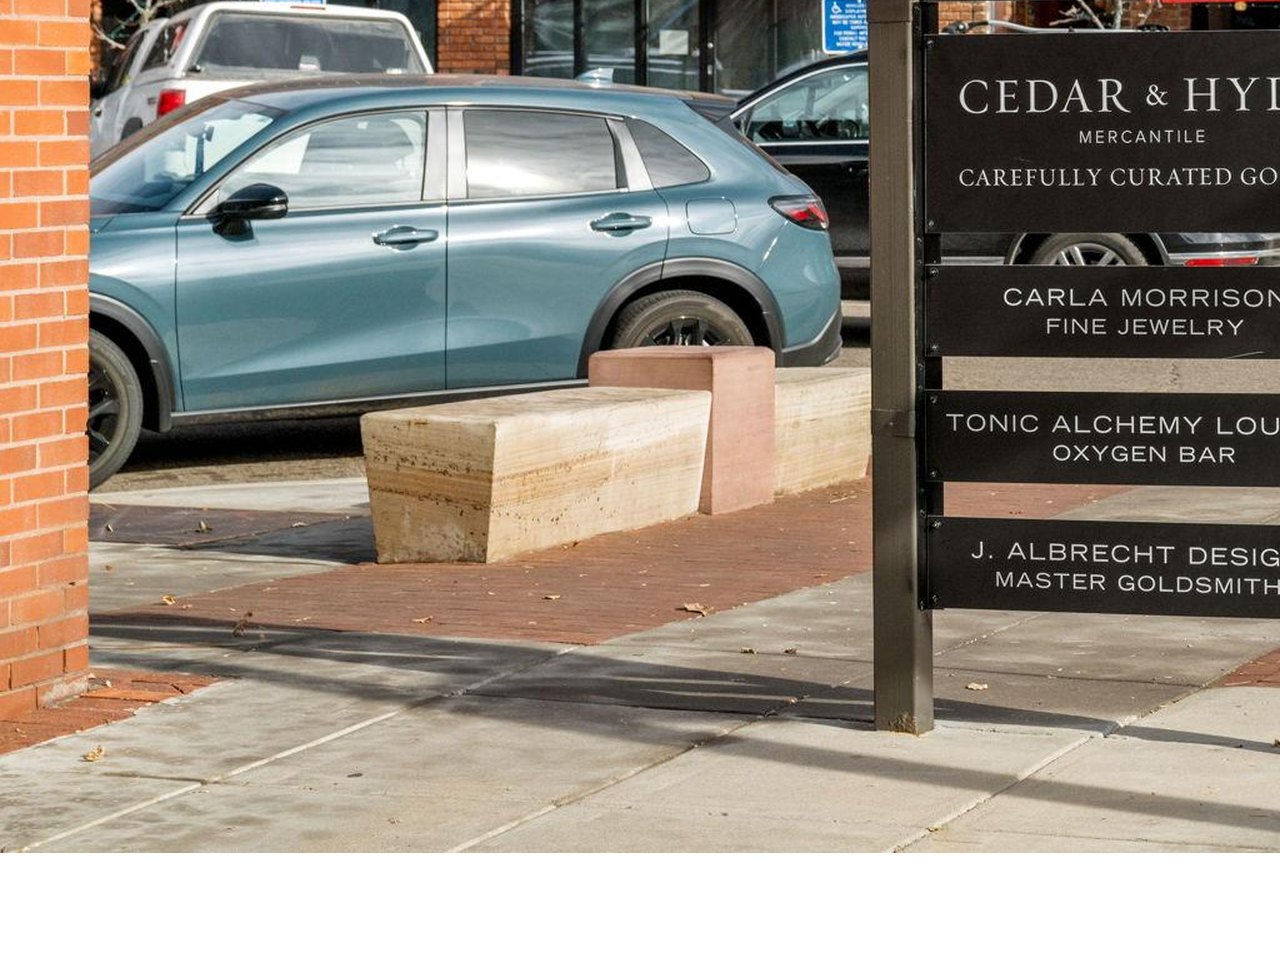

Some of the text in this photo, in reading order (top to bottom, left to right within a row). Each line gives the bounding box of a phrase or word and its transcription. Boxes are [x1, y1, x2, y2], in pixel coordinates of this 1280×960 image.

[959, 79, 1131, 114] CEDAR
[1145, 83, 1168, 106] &
[1079, 129, 1206, 144] MERCANTILE
[958, 168, 1102, 187] CAREFULLY
[1110, 167, 1232, 187] CURATED
[1003, 287, 1108, 307] CARLA
[1046, 318, 1244, 336] FINE JEWELRY
[945, 413, 1039, 433] TONIC
[1051, 414, 1203, 435] ALCHEMY
[1052, 444, 1235, 464] OXYGEN BAR
[971, 540, 993, 559] J.
[1007, 541, 1176, 564] ALBRECHT
[995, 571, 1106, 591] MASTER
